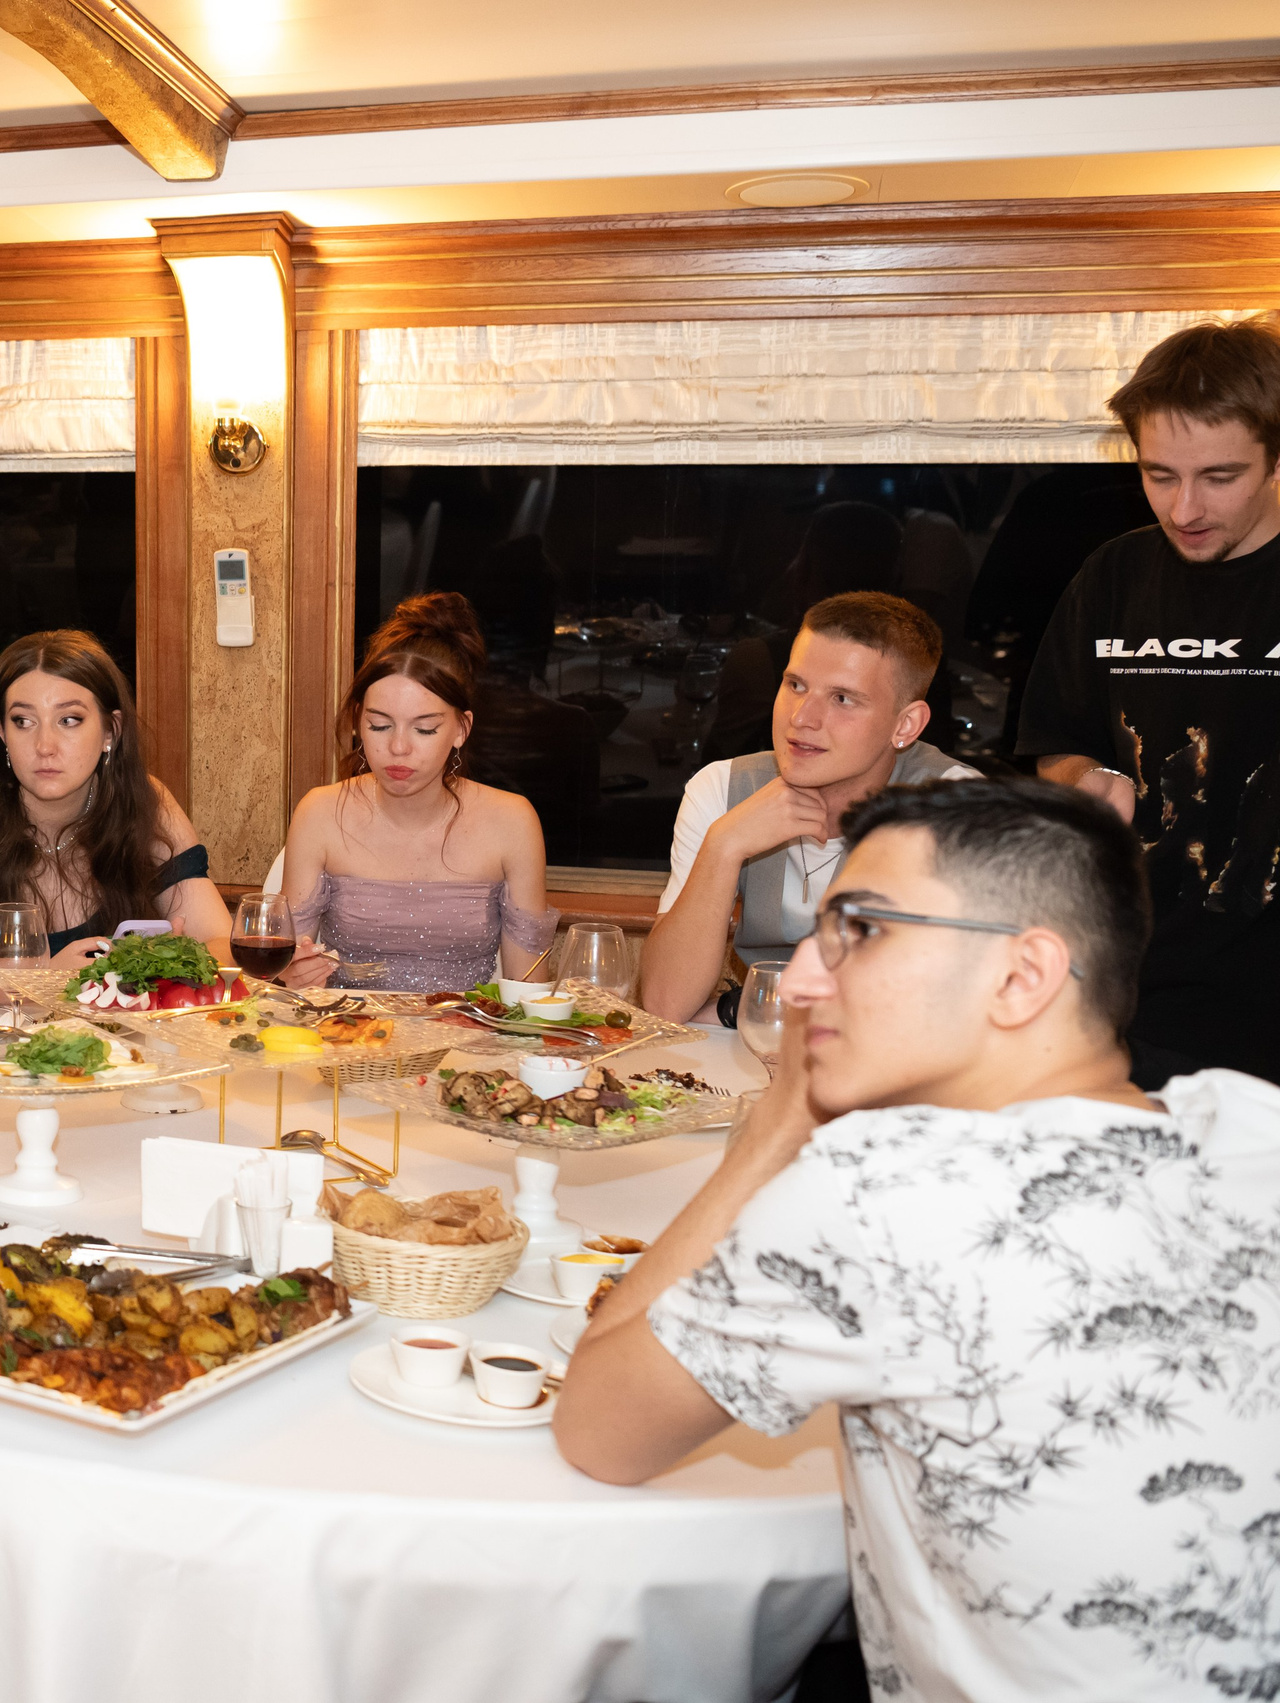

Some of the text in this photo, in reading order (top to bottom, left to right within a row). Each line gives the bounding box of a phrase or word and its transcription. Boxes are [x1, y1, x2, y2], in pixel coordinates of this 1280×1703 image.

[1160, 667, 1186, 675] DECENT
[1186, 668, 1202, 676] MAN
[1248, 668, 1273, 676] CAN'T
